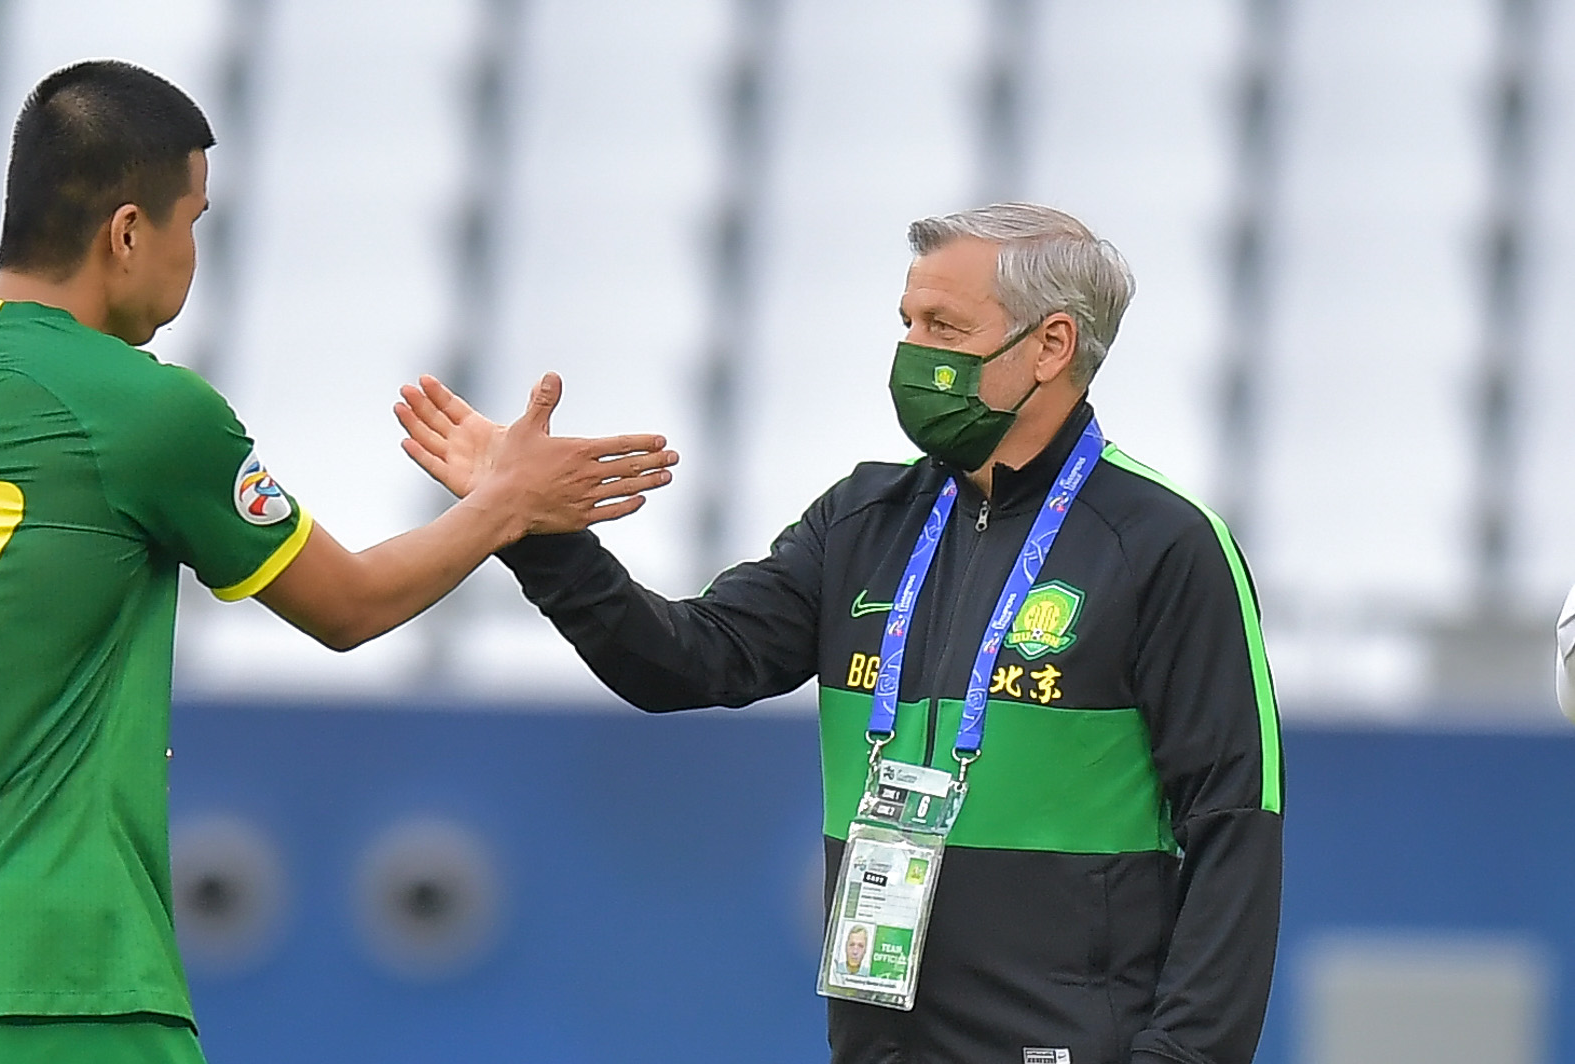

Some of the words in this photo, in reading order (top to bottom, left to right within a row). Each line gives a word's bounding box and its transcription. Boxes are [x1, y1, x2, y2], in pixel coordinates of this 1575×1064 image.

[1011, 632, 1060, 649] GUAN
[846, 652, 881, 690] BG
[989, 663, 1062, 704] 北京
